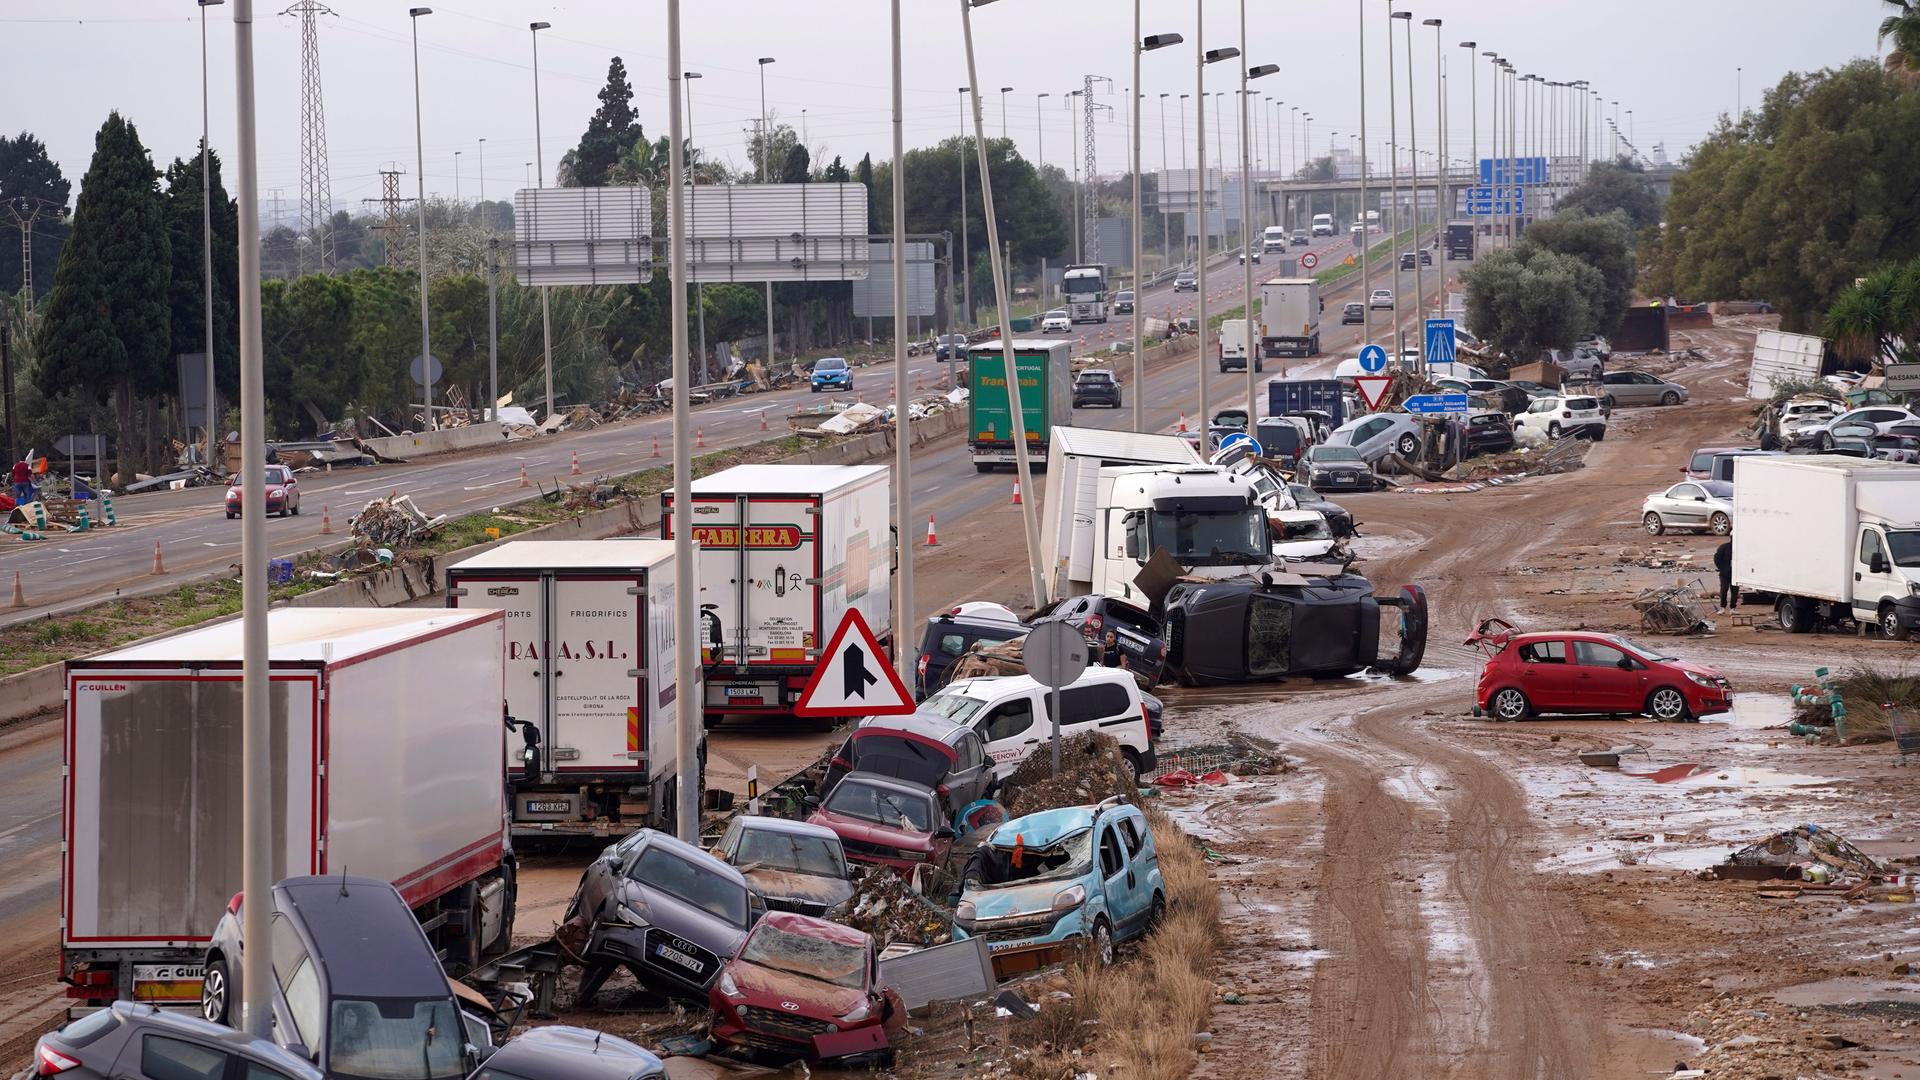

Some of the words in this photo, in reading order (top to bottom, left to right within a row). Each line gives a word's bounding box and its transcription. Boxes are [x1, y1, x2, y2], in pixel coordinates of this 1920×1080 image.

[694, 528, 793, 545] CABRERA
[570, 610, 628, 618] FRIGORIFICS
[992, 751, 1017, 761] EENOW
[175, 968, 206, 977] GUIL
